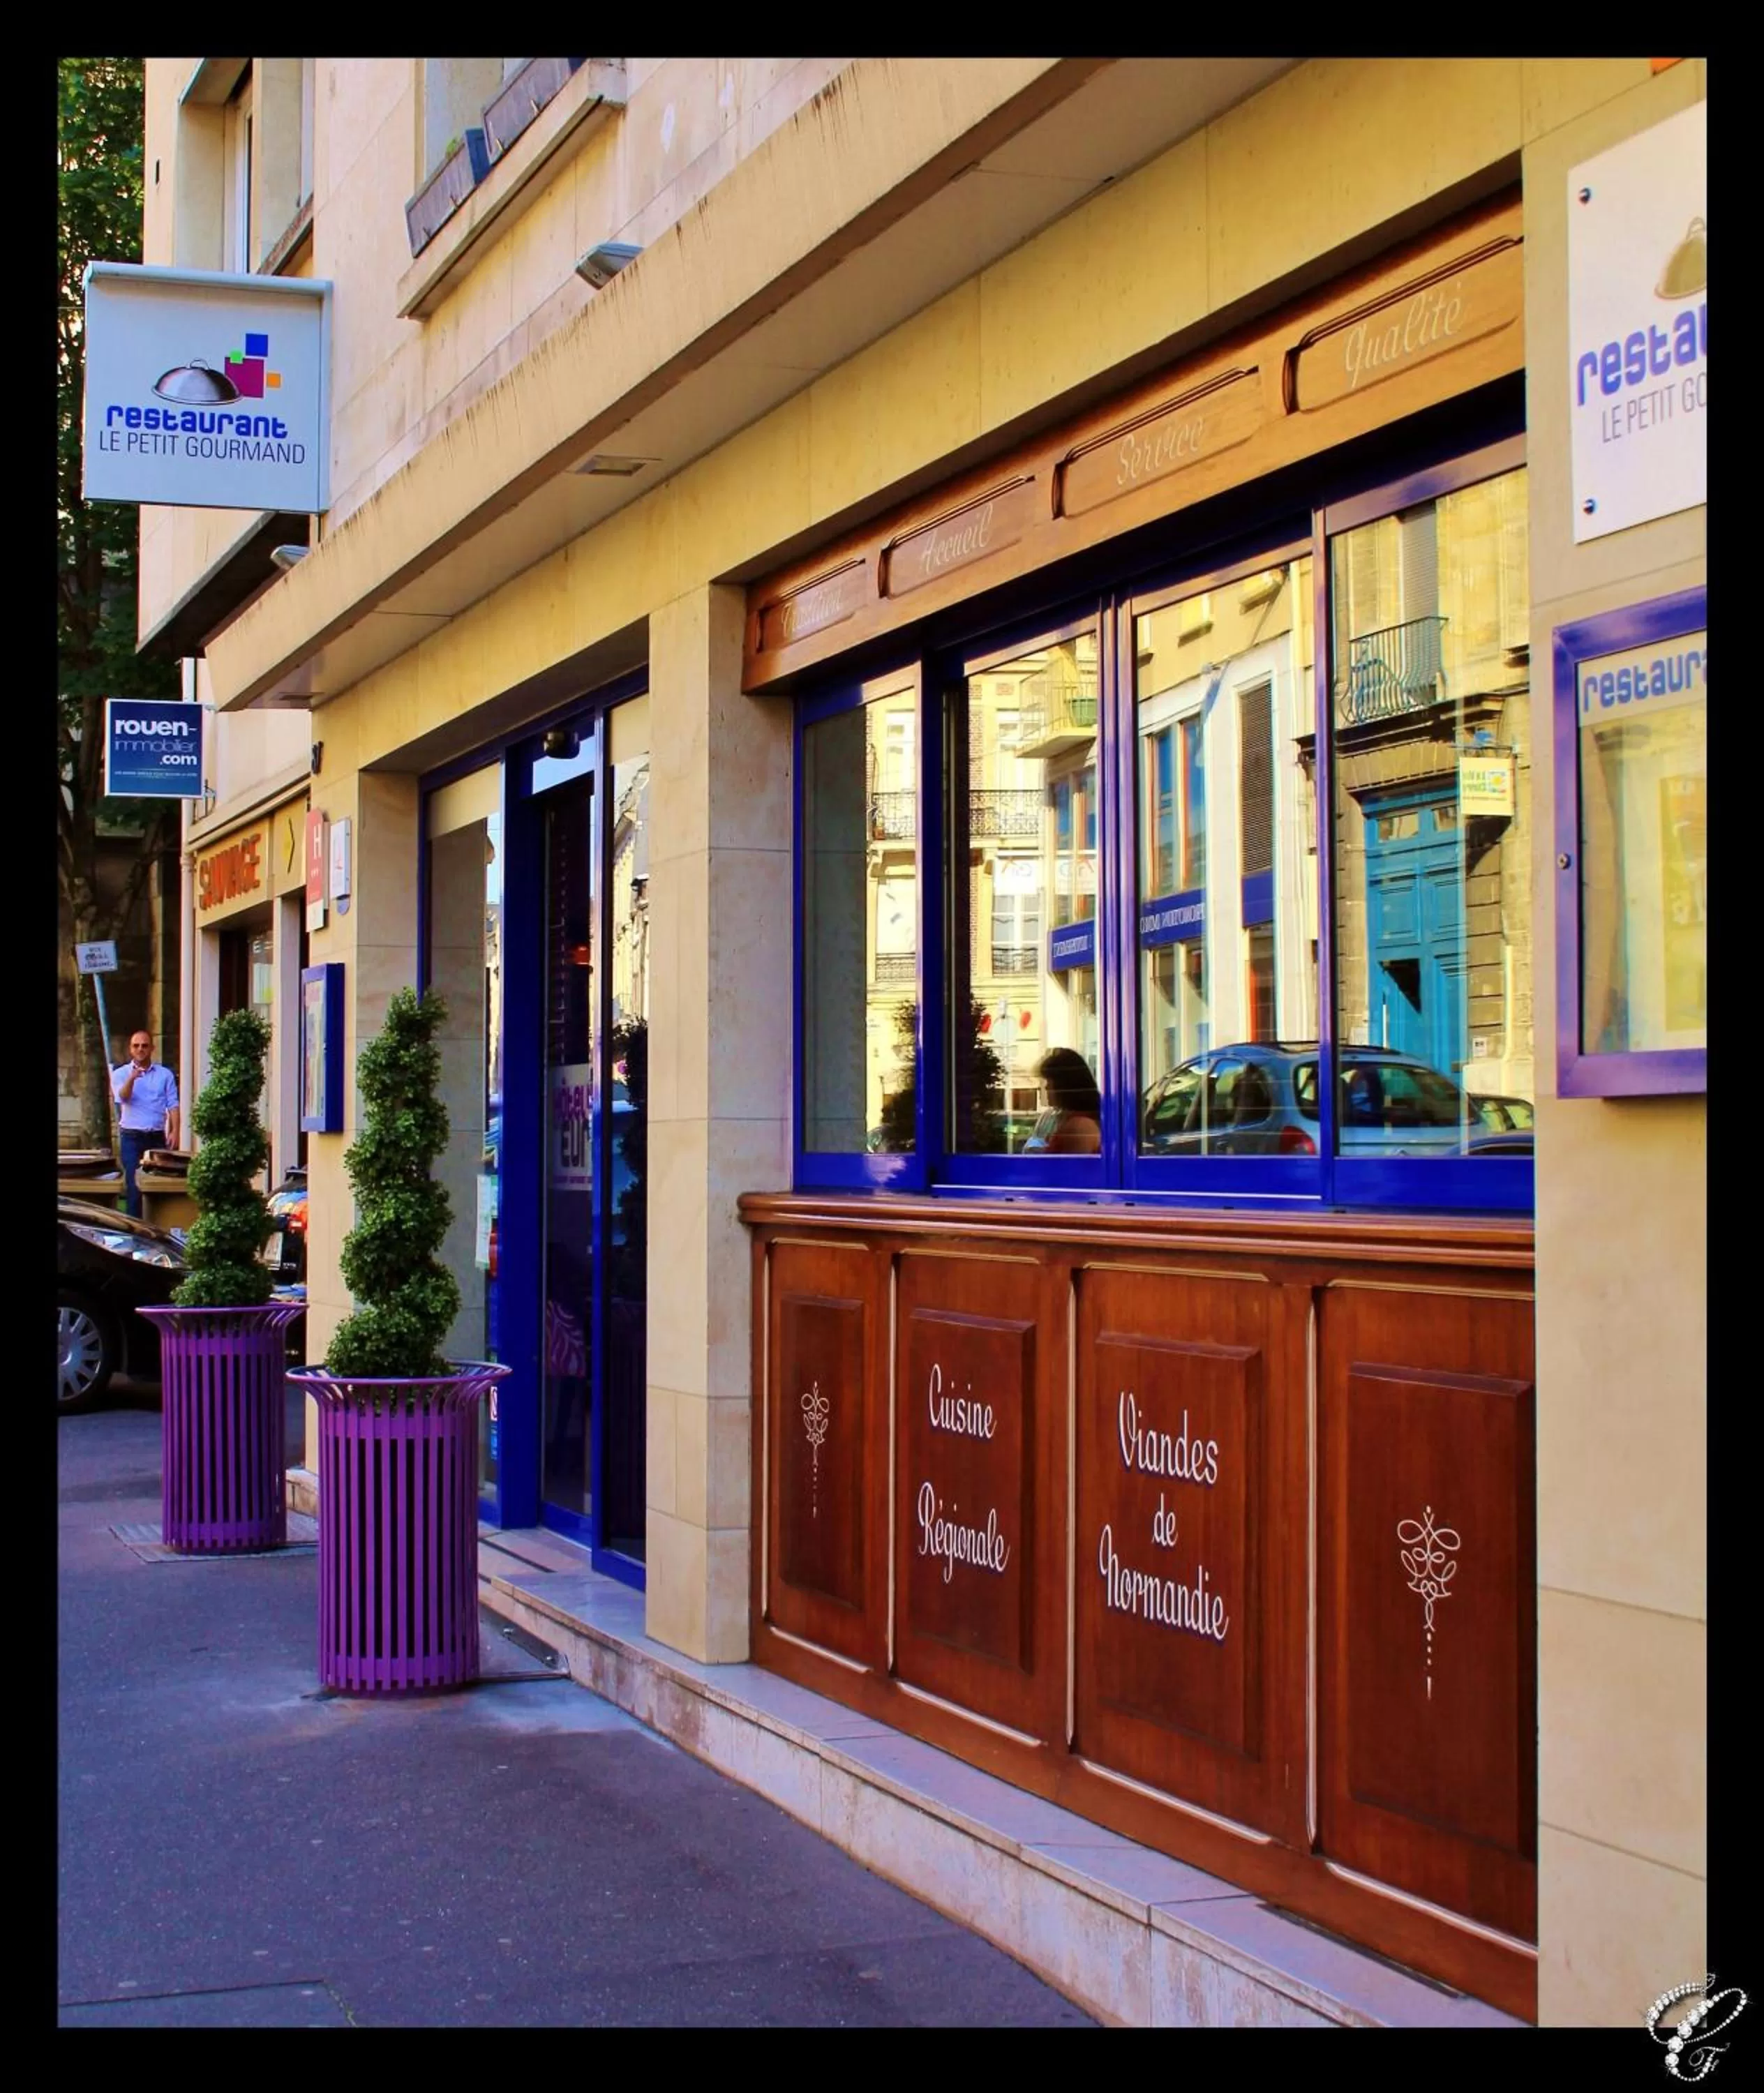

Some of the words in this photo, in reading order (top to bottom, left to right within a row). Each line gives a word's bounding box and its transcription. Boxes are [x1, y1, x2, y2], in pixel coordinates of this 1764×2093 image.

[1345, 282, 1463, 387] Qualité
[99, 430, 120, 452] LE
[127, 432, 180, 456] PETIT
[186, 436, 305, 464] GOURMAND
[106, 405, 288, 440] restaurant
[1602, 404, 1622, 444] LE
[1627, 382, 1676, 435] PETIT
[1118, 417, 1204, 485] Service
[921, 503, 993, 575] Accueil
[114, 719, 197, 736] rouen-
[160, 754, 197, 765] .com
[929, 1363, 997, 1439] Cuisine
[1119, 1392, 1218, 1485] Viandes
[918, 1482, 1010, 1584] Régionale
[1151, 1493, 1178, 1547] de
[1099, 1524, 1229, 1640] Normandie
